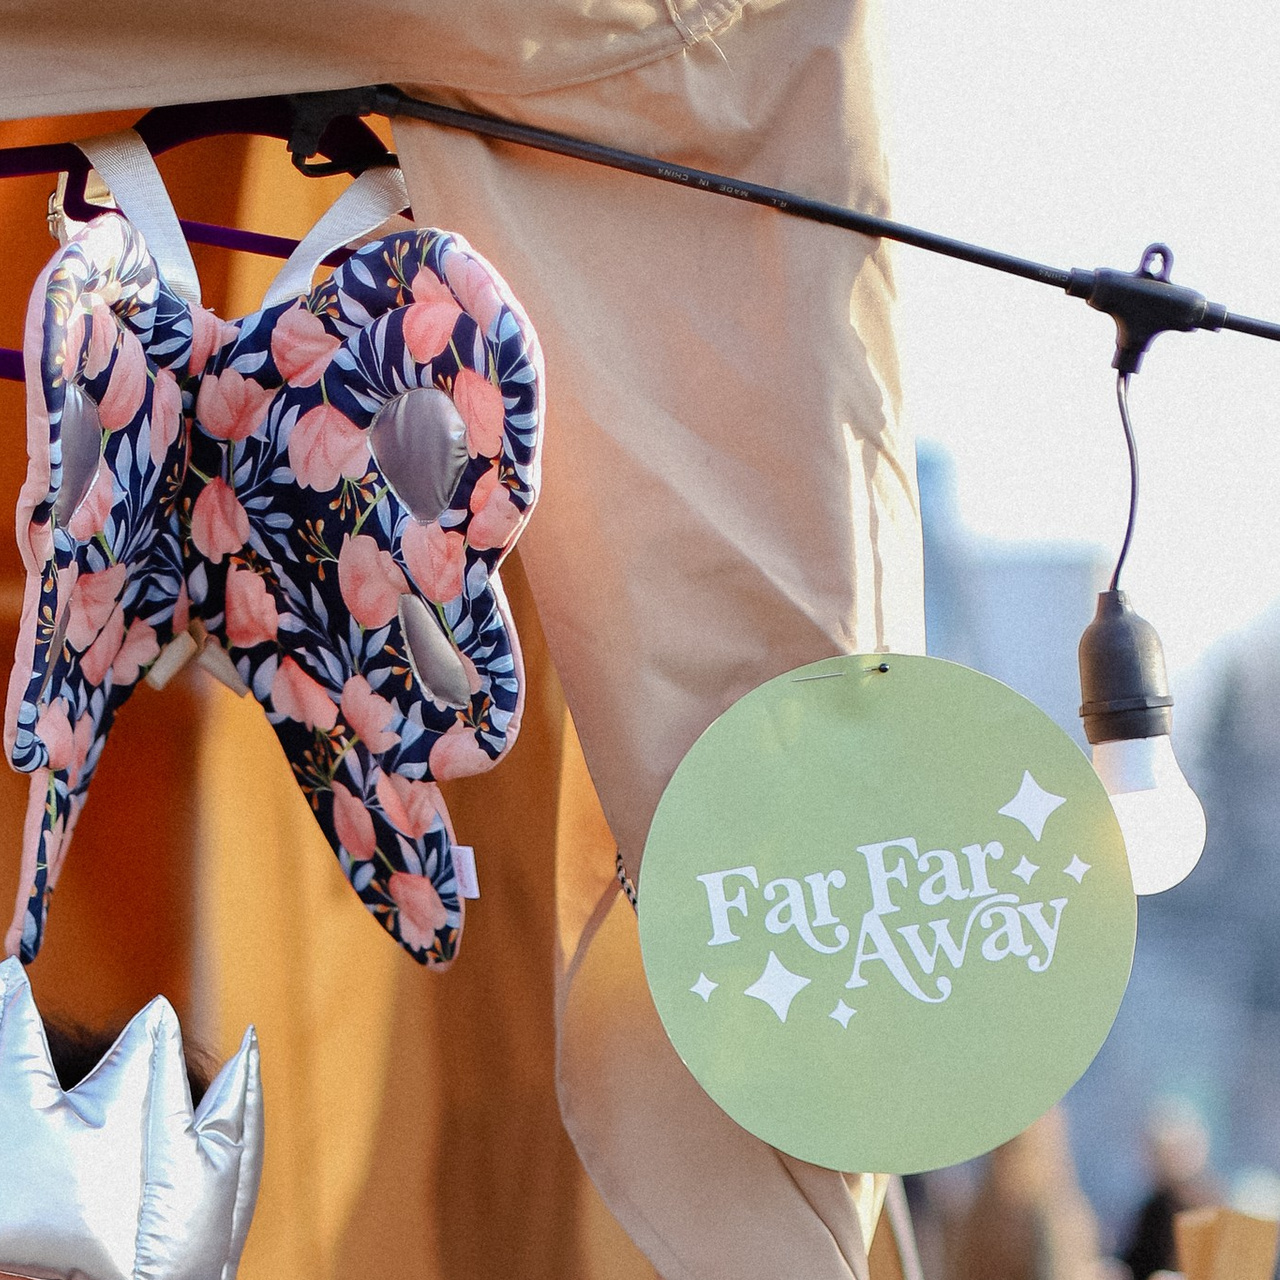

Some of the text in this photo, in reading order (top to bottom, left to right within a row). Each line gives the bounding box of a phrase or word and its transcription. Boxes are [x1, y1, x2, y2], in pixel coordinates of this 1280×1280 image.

[658, 167, 689, 181] CHINA
[699, 178, 710, 187] IN
[719, 184, 750, 198] MADE
[696, 836, 1004, 954] Far Far
[845, 893, 1069, 1004] Away
